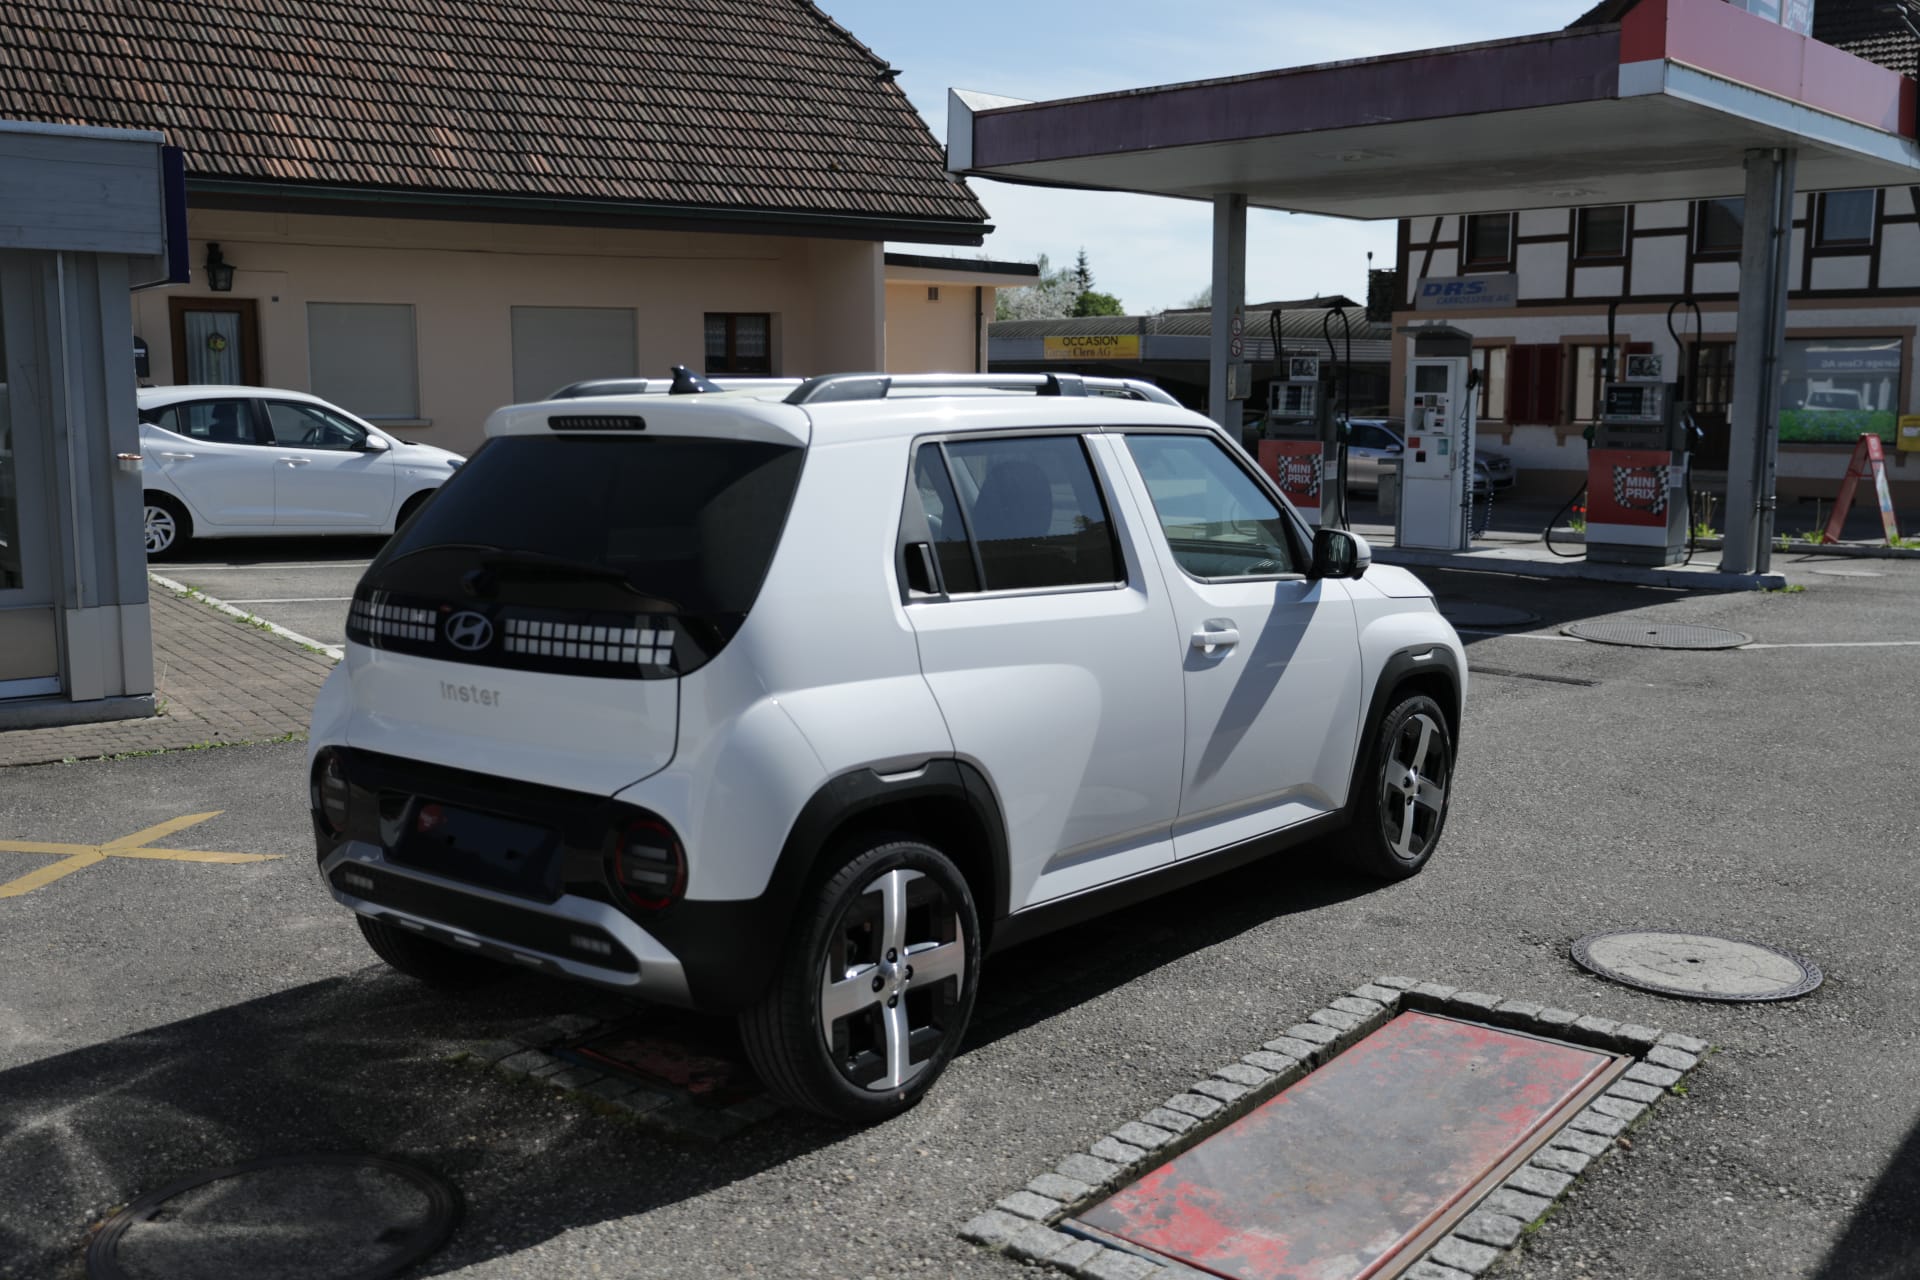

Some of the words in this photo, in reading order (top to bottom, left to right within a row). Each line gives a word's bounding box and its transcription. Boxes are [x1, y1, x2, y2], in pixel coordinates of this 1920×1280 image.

[1423, 281, 1484, 296] DRS
[1062, 335, 1119, 346] OCCASION
[1096, 347, 1111, 357] AG
[1288, 464, 1311, 474] MINI
[1287, 474, 1311, 485] PRIX
[1626, 477, 1656, 487] MINI
[1625, 488, 1656, 500] PRIX
